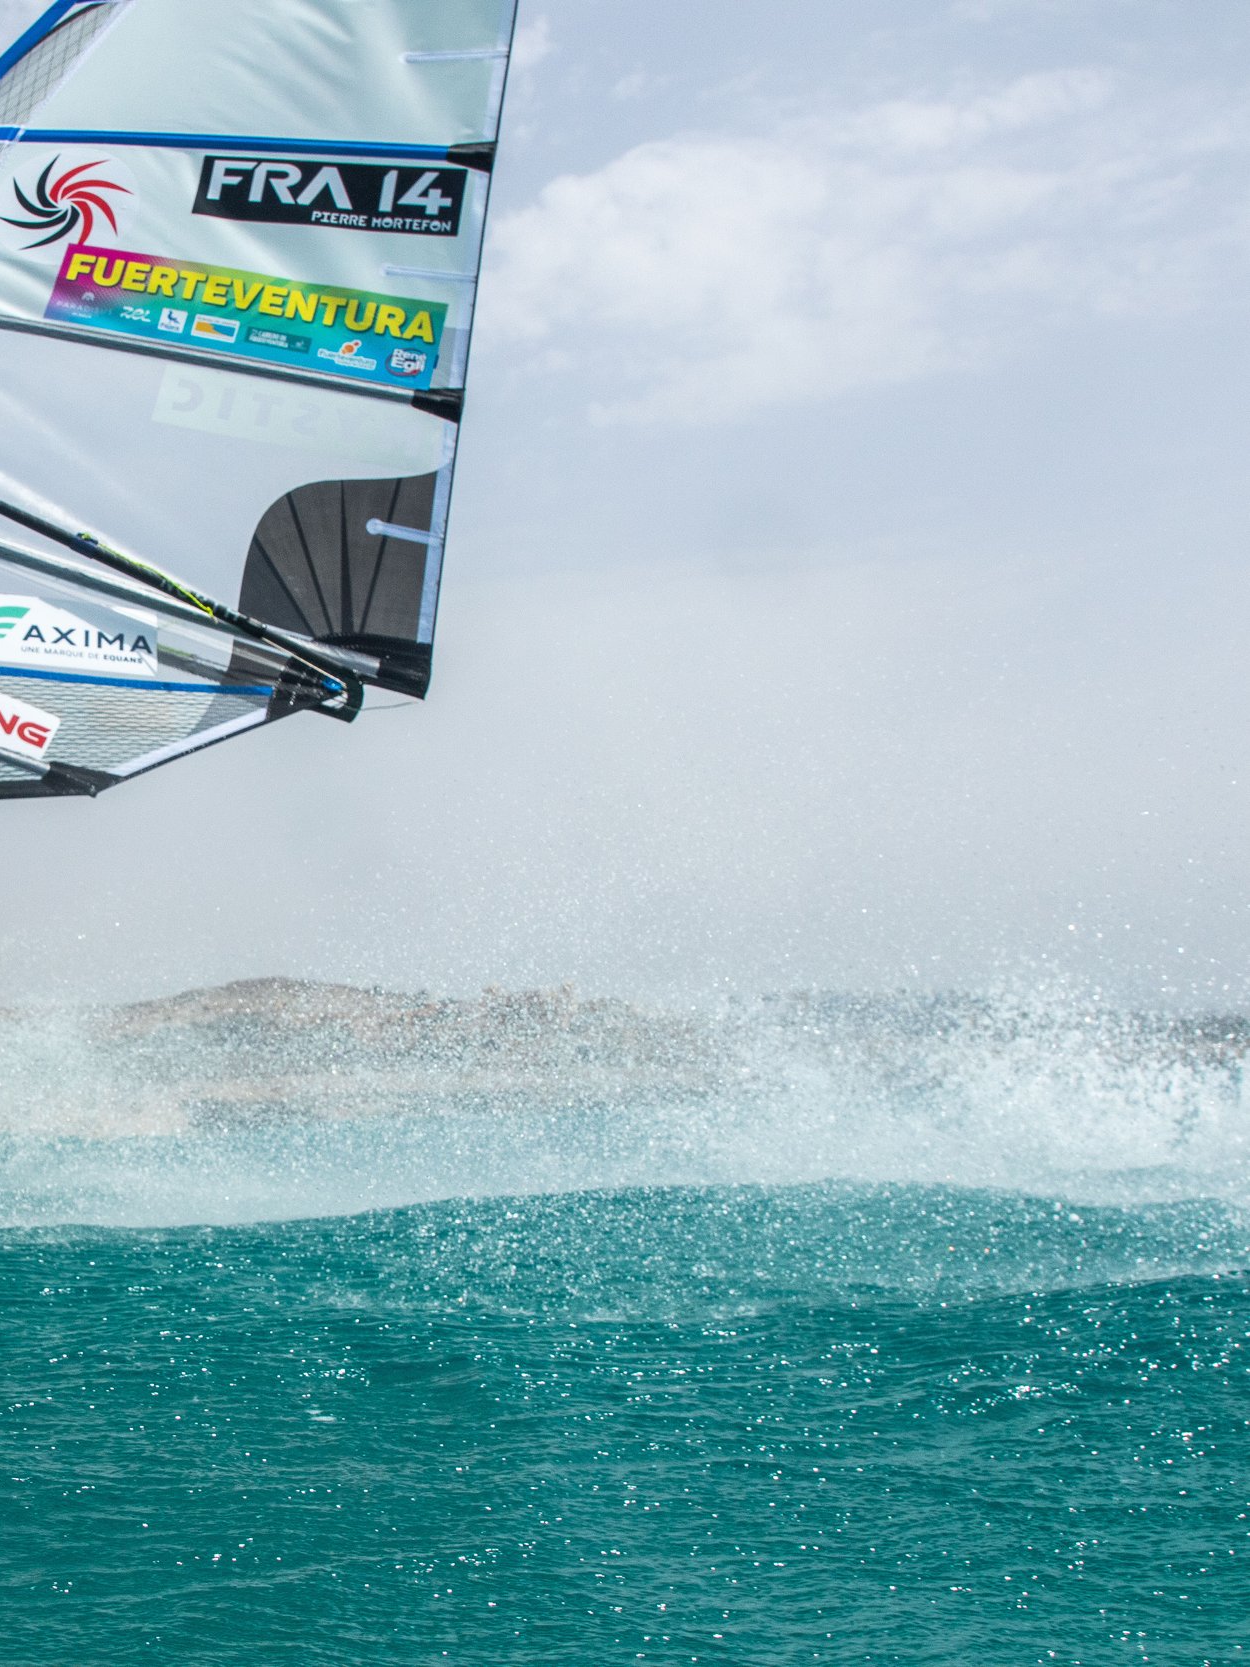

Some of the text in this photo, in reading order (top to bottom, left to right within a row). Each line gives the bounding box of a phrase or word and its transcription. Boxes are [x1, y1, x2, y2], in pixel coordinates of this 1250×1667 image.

[206, 159, 452, 215] FRA 14
[311, 211, 367, 227] PIERRE
[65, 253, 435, 343] FUERTEVENTURA
[23, 625, 153, 654] AXIMA
[21, 646, 40, 654] UNE
[44, 648, 84, 658] MARQUE
[103, 654, 143, 664] EQUANS
